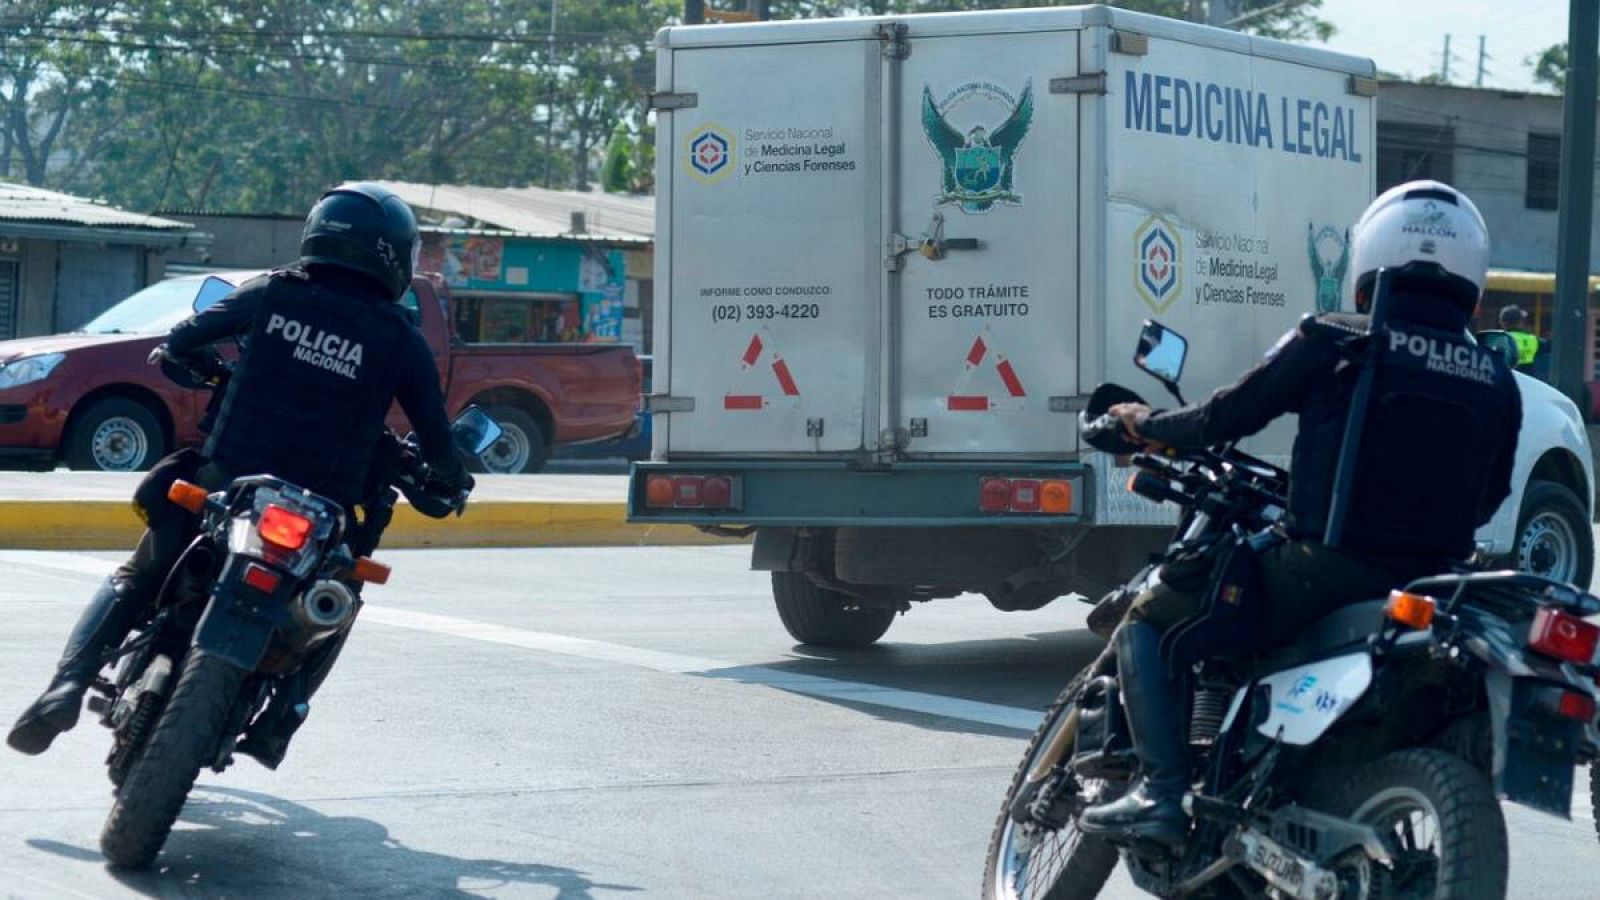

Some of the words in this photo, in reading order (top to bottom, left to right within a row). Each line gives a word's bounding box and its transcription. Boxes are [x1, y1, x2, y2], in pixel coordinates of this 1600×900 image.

[1125, 70, 1273, 149] MEDICINA
[1281, 97, 1362, 163] LEGAL
[744, 128, 786, 141] Servicio
[787, 126, 833, 139] Nacional
[744, 146, 759, 157] de
[761, 143, 811, 156] Medicina
[814, 142, 846, 158] Legal
[744, 164, 752, 176] y
[754, 160, 801, 173] Ciencias
[803, 159, 856, 172] Forenses
[1209, 256, 1254, 278] Medicina
[1254, 261, 1279, 286] Legal
[700, 286, 741, 297] INFORME
[743, 286, 773, 297] COMO
[926, 286, 965, 300] TODO
[968, 283, 1030, 300] TRÁMITE
[1195, 287, 1202, 305] y
[1203, 282, 1245, 304] Ciencias
[1246, 286, 1286, 308] Forenses
[712, 303, 742, 323] (02)
[746, 302, 820, 320] 393-4220
[928, 304, 948, 319] ES
[951, 302, 1030, 318] GRATUITO
[266, 313, 363, 367] POLICIA
[293, 345, 357, 380] NACIONAL
[1388, 330, 1495, 376] POLICIA
[1427, 359, 1495, 385] NACIONAL
